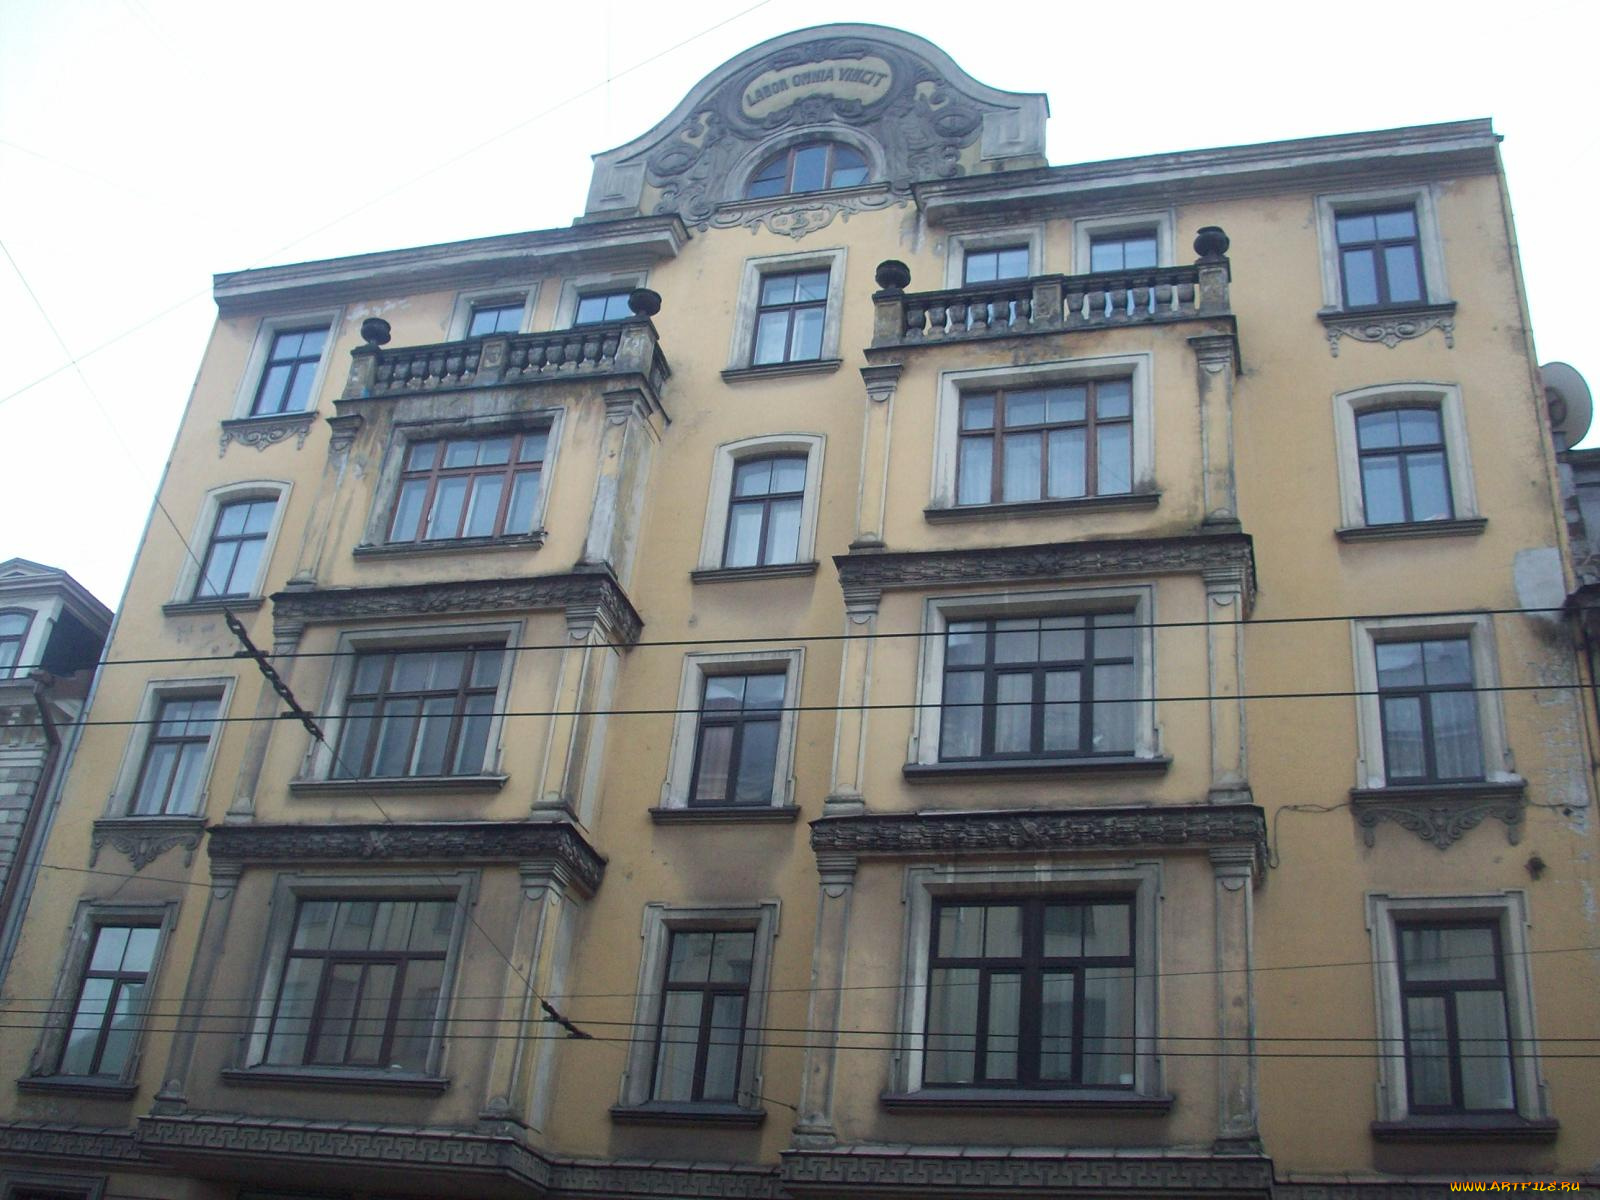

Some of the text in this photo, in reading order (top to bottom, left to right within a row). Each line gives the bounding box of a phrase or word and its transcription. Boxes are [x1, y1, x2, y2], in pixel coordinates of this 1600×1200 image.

[747, 67, 889, 107] LABOR OMNIA VINCIT
